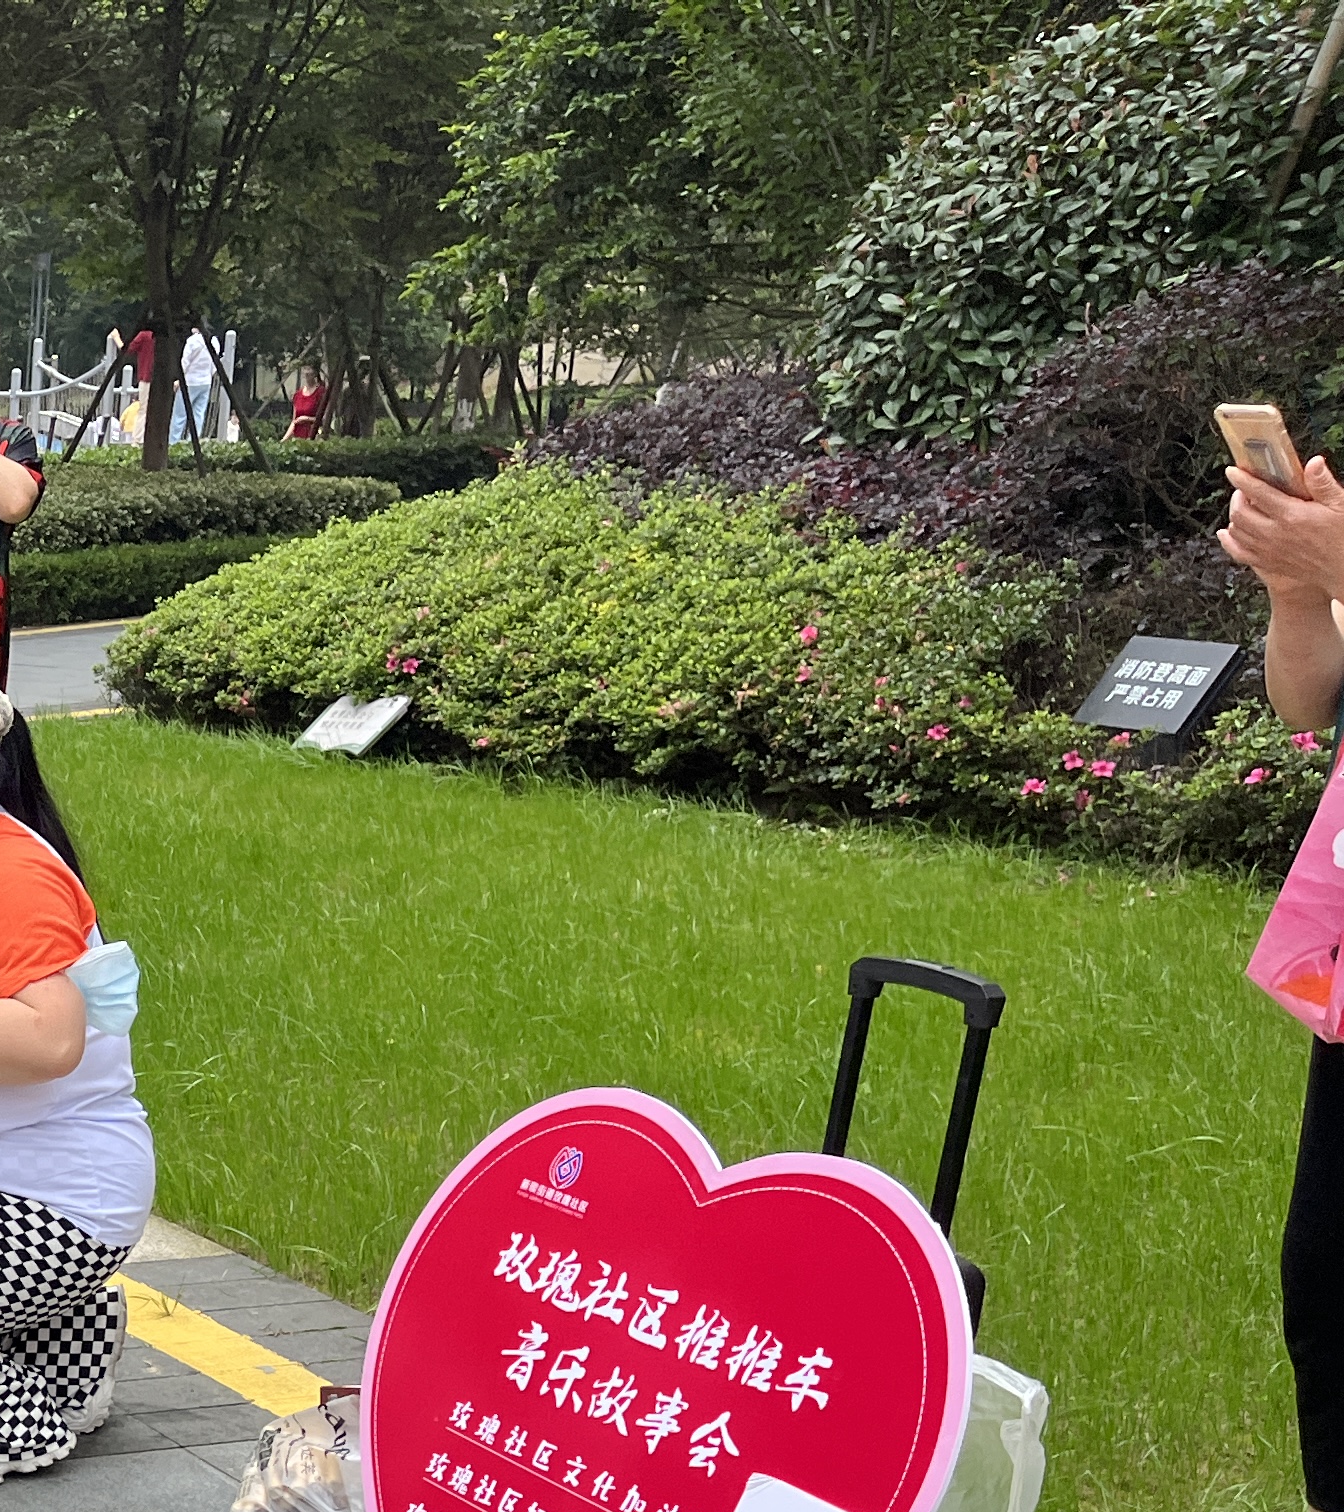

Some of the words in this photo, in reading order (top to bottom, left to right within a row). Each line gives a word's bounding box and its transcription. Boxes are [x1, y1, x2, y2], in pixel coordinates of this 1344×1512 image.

[1104, 683, 1184, 710] 严禁占用
[1114, 658, 1211, 687] 消防登高面
[493, 1231, 833, 1412] 玫瑰社区推推车
[501, 1320, 740, 1478] 音乐故事会
